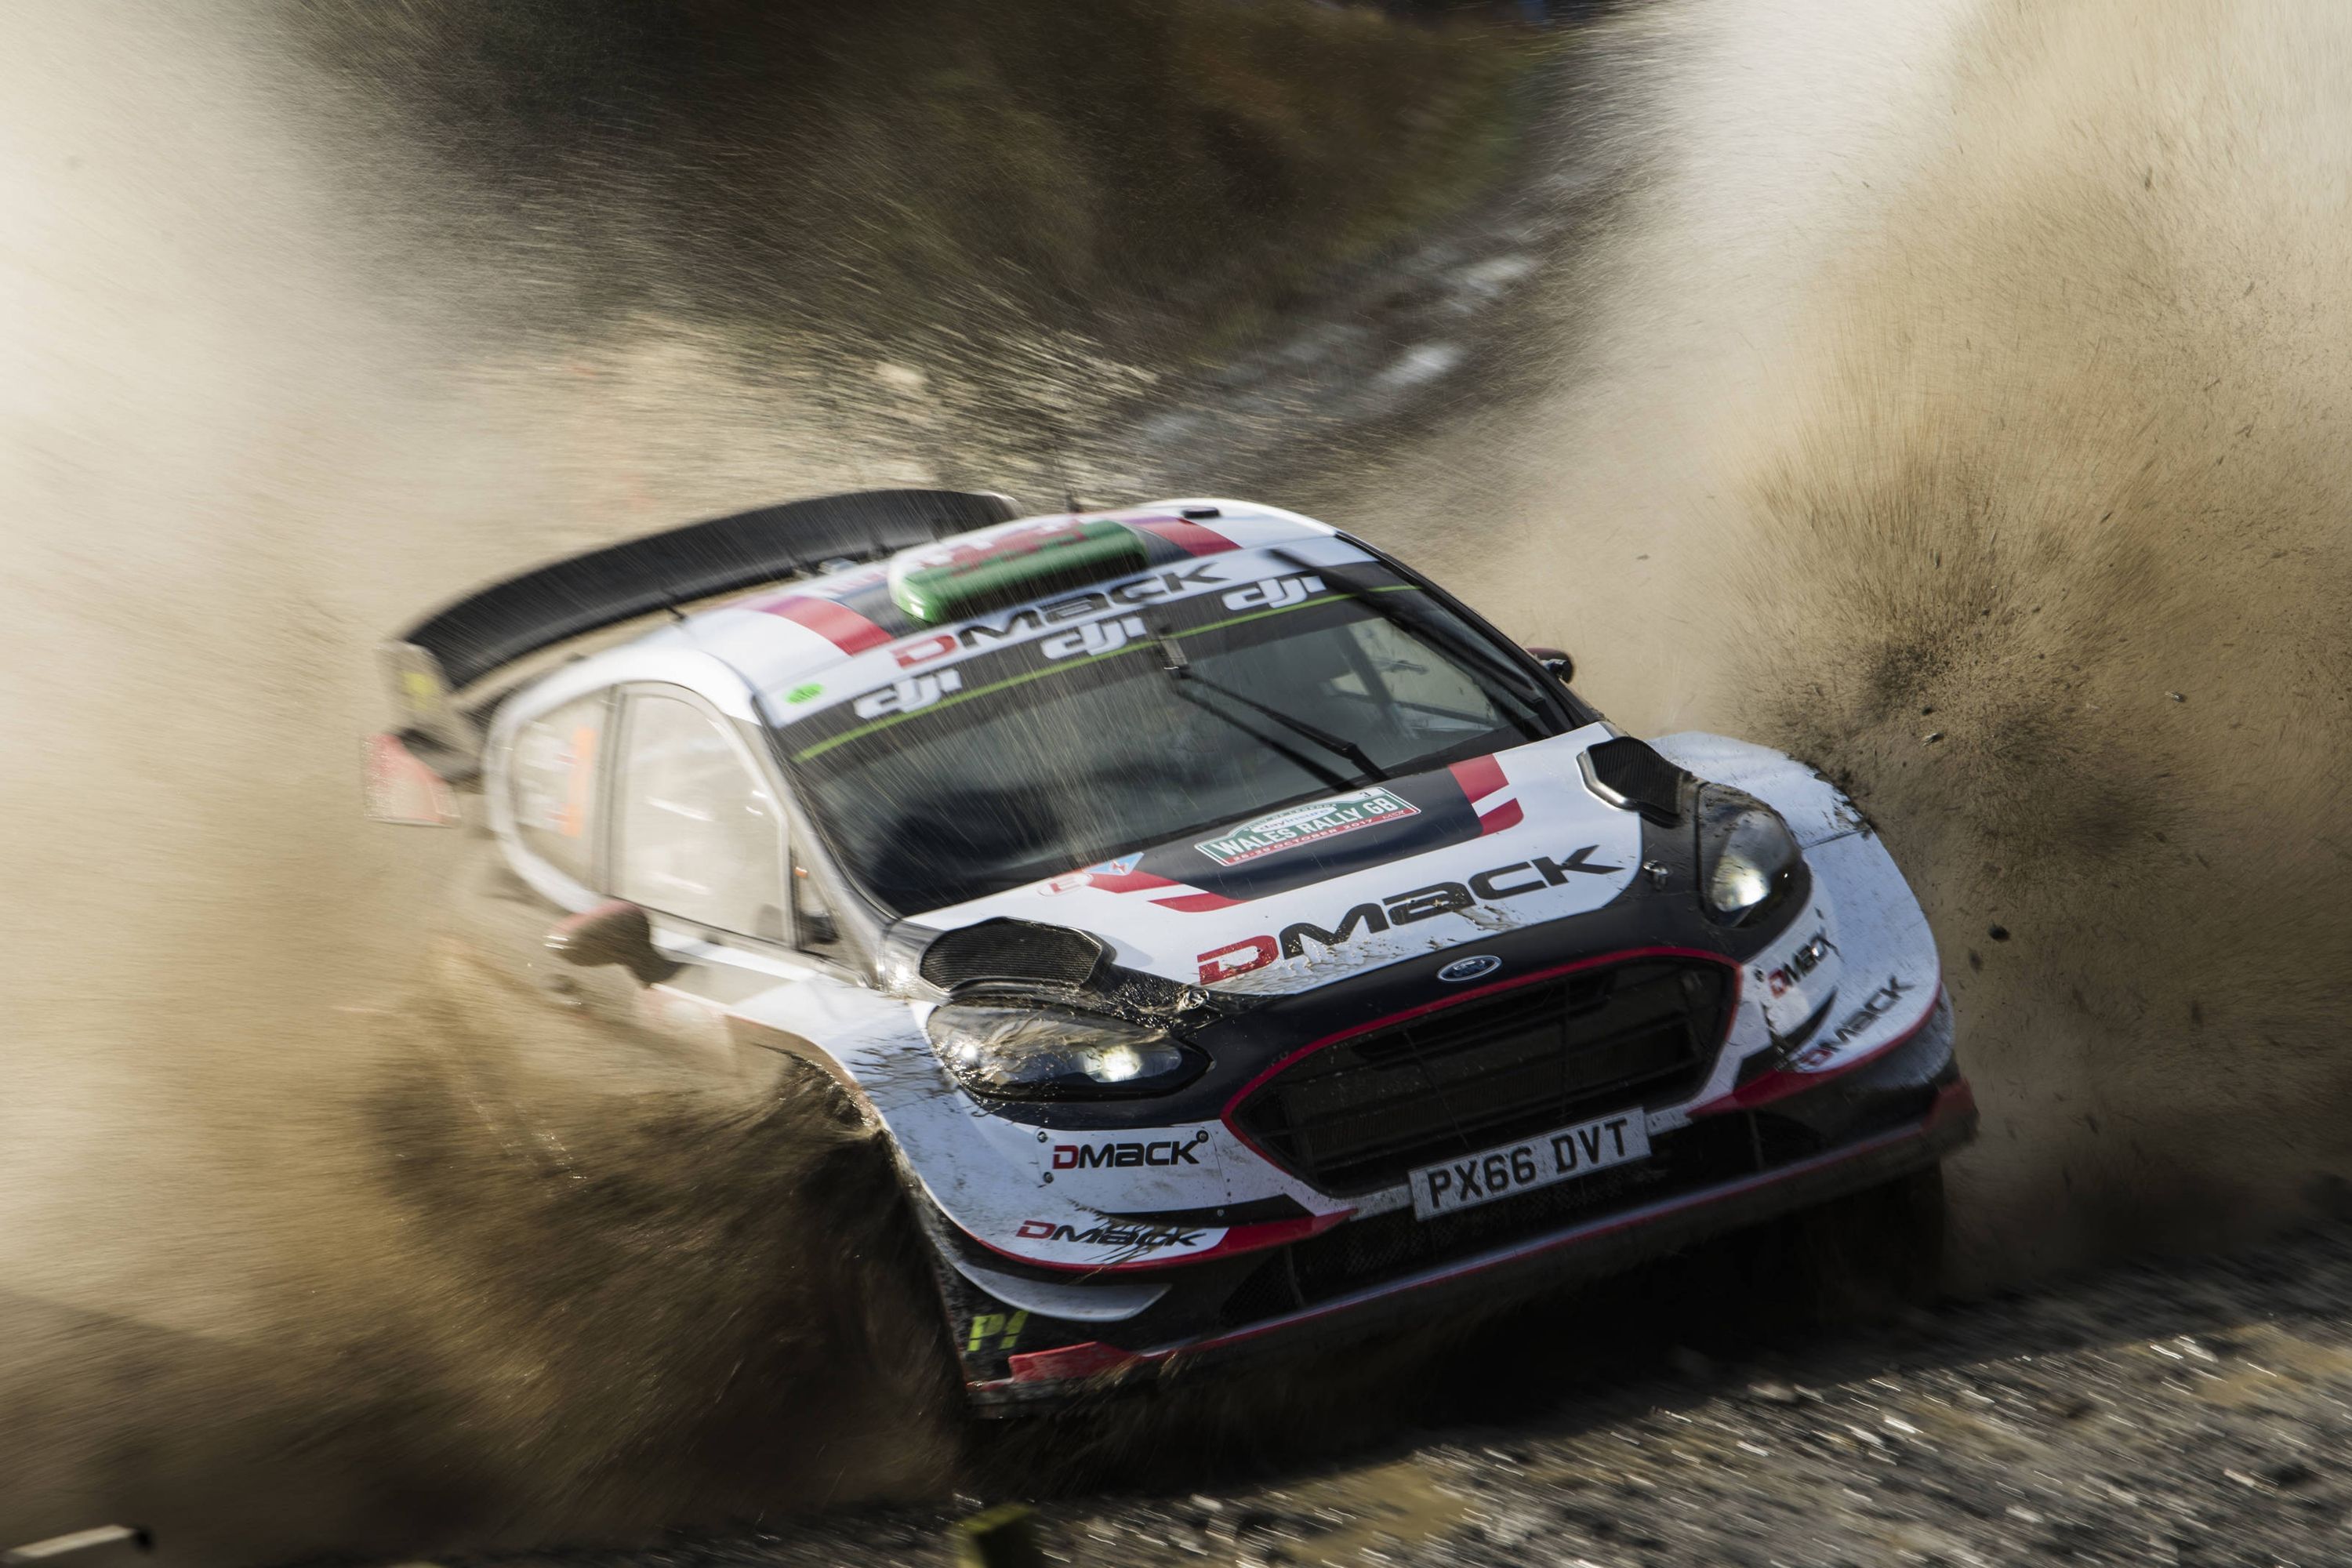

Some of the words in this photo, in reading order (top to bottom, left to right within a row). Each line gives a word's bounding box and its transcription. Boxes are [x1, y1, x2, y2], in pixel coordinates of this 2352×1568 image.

[1211, 827, 1298, 856] WALES
[1296, 807, 1364, 834] RALLY
[1363, 797, 1399, 815] GB
[1274, 829, 1338, 849] OCTOBER
[1344, 818, 1373, 830] 2017
[1427, 1145, 1537, 1208] PX66
[1551, 1119, 1628, 1175] DVT
